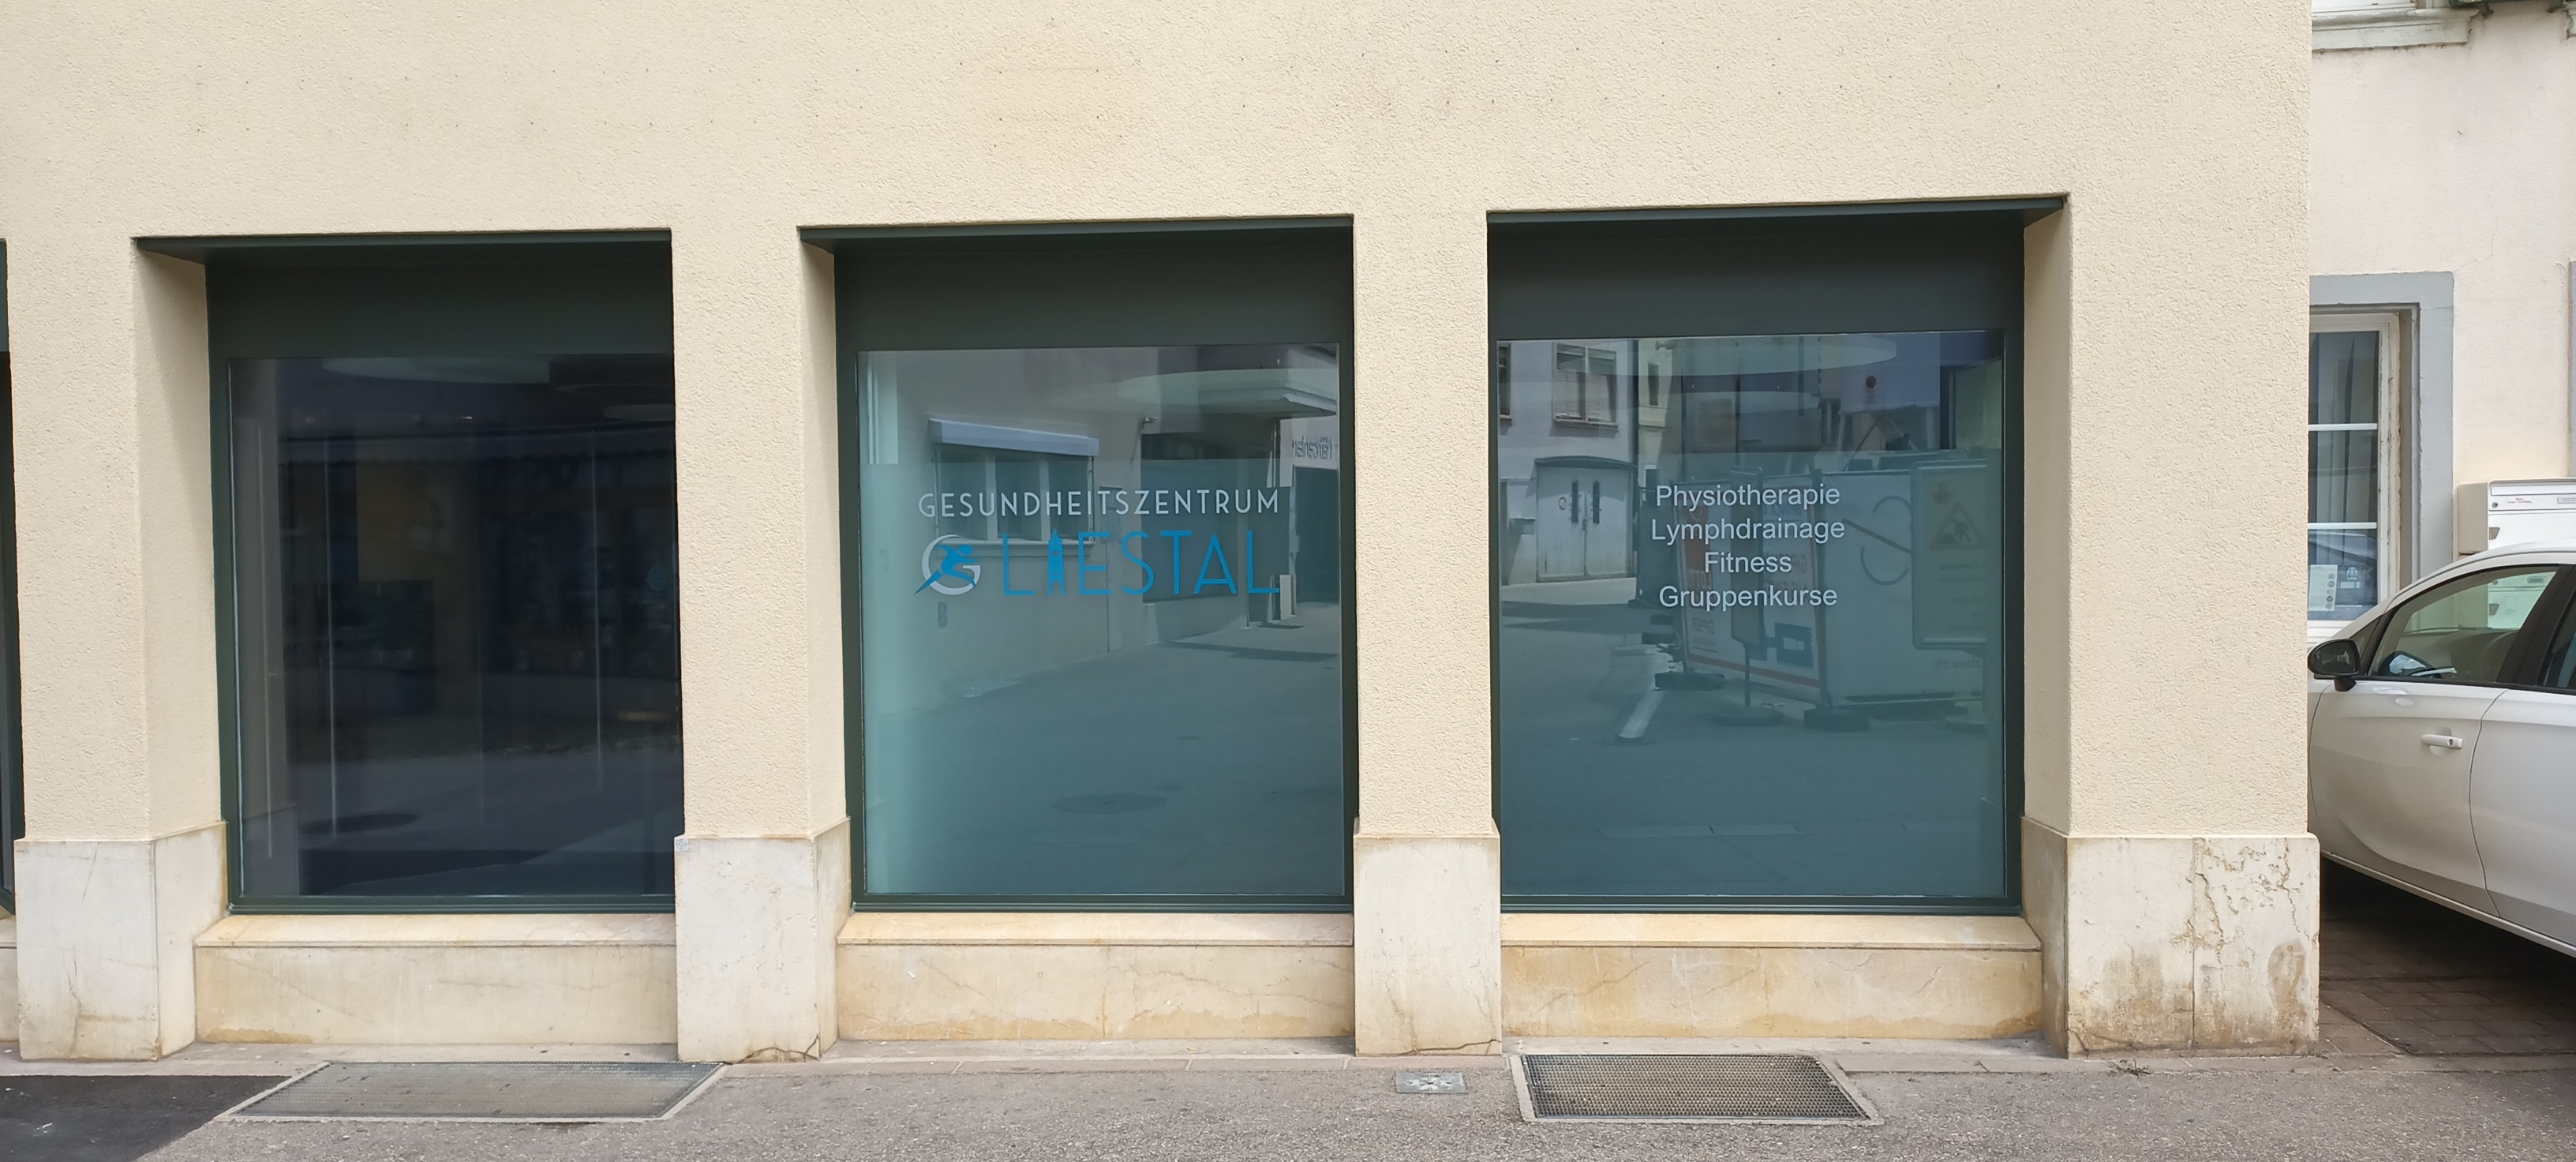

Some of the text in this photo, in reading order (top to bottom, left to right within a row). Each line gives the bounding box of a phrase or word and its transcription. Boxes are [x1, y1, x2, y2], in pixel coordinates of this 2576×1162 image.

[918, 489, 1279, 518] GESUNDHEITSZENTRUM
[1656, 483, 1840, 512] Physiotherapie
[1652, 517, 1845, 546] Lymphdrainage
[1002, 528, 1280, 596] LIESTAL
[1705, 551, 1792, 574] Fitness
[1659, 585, 1838, 613] Gruppenkurse
